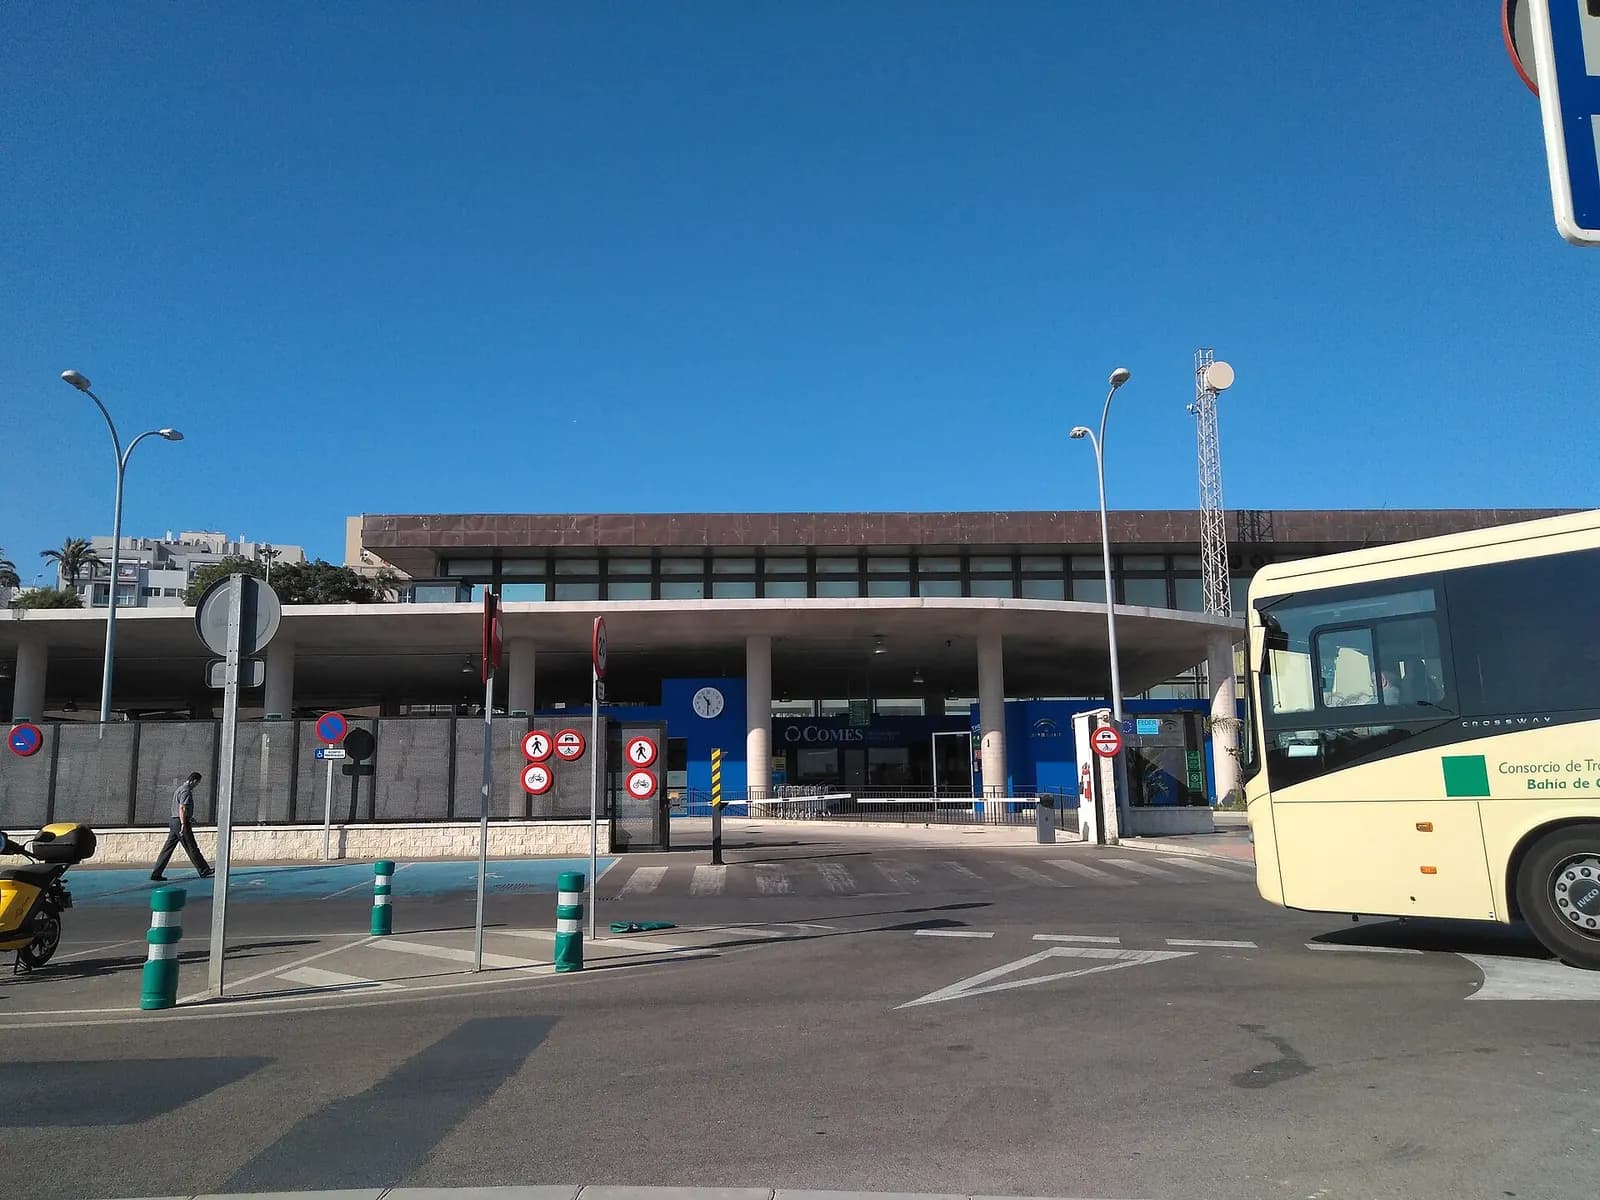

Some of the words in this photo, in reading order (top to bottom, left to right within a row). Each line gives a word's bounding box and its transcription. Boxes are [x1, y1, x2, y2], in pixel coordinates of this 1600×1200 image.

[1498, 761, 1561, 774] Consorcio
[1565, 760, 1582, 772] de
[1527, 777, 1567, 790] Bahía
[1572, 776, 1590, 789] de
[1576, 888, 1599, 908] IVECO
